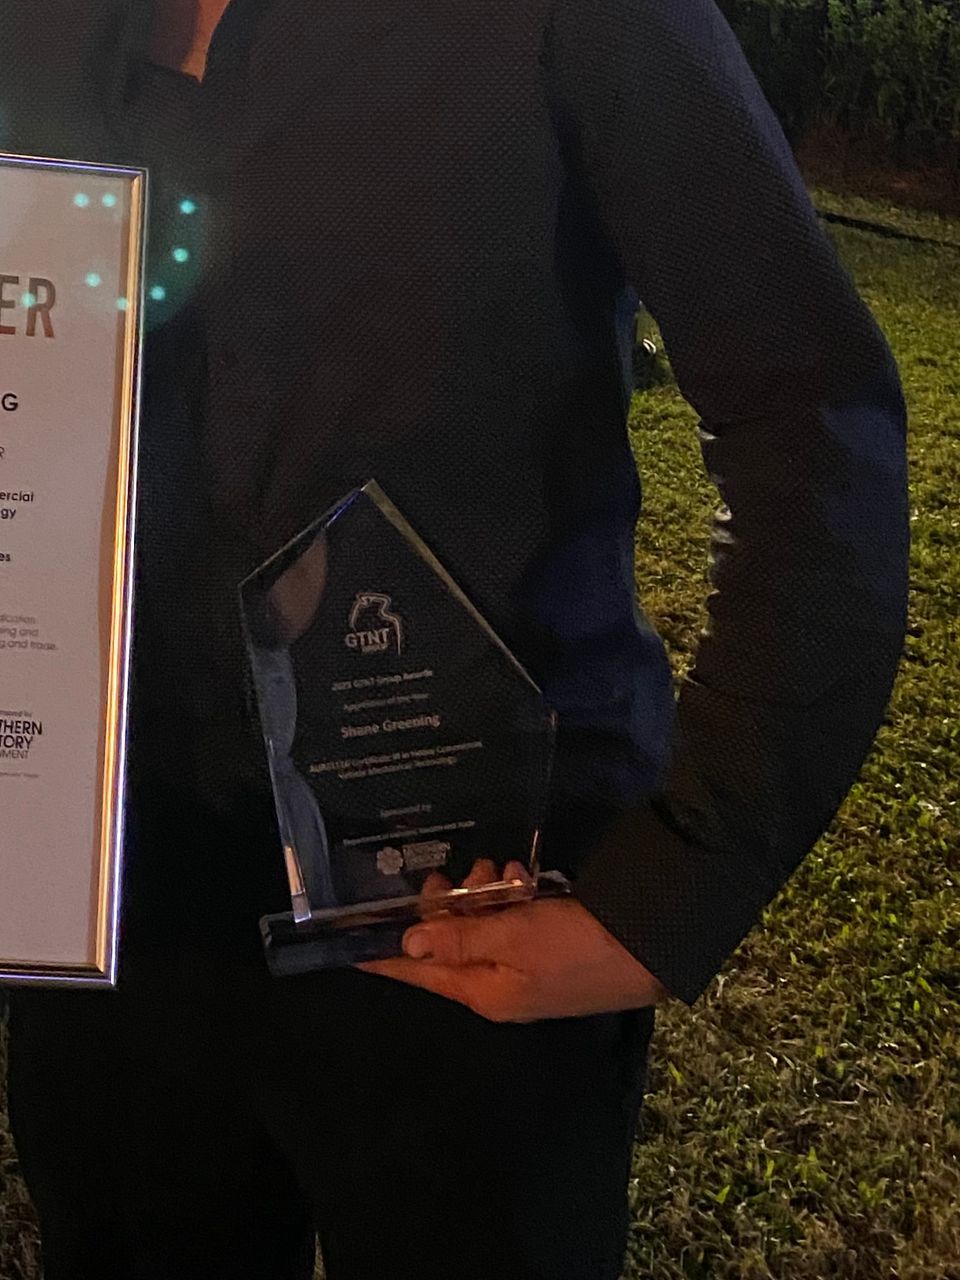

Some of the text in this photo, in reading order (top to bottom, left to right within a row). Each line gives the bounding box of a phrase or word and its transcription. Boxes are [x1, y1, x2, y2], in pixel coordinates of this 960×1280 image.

[344, 628, 390, 648] GTNT
[340, 714, 441, 738] Shane Greening
